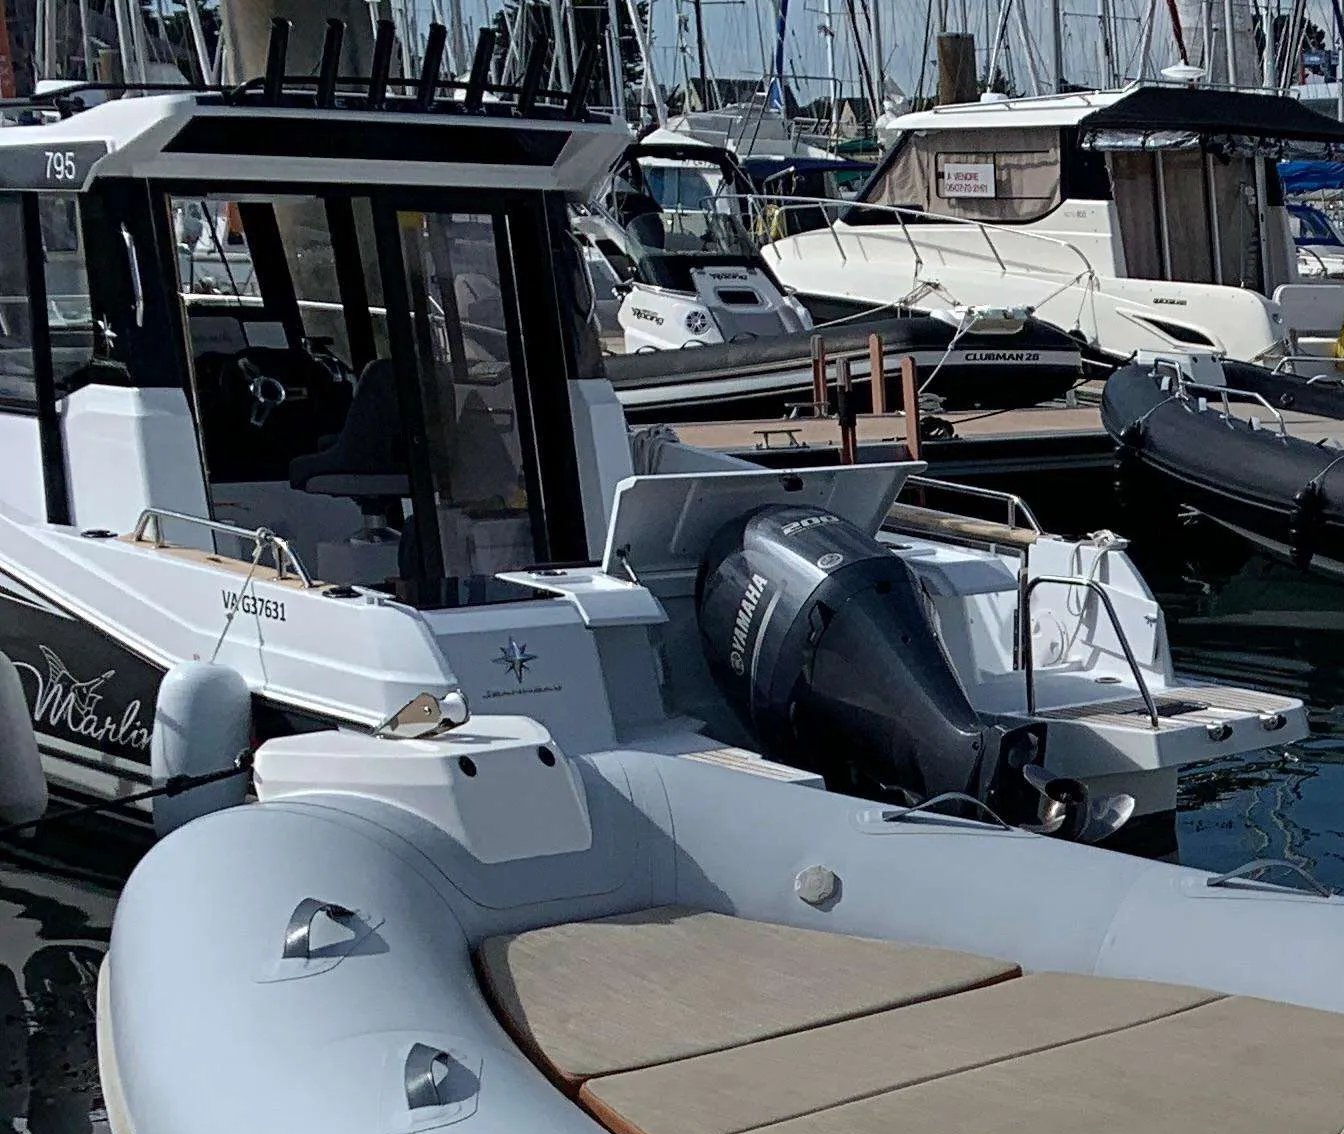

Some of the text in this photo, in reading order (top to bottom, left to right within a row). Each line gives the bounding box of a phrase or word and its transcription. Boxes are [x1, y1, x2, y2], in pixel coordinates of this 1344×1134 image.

[44, 151, 76, 179] 795
[965, 353, 1023, 361] CLUBMAN
[780, 515, 840, 535] 200
[222, 590, 286, 621] VA G37631
[731, 573, 768, 654] YAMAHA
